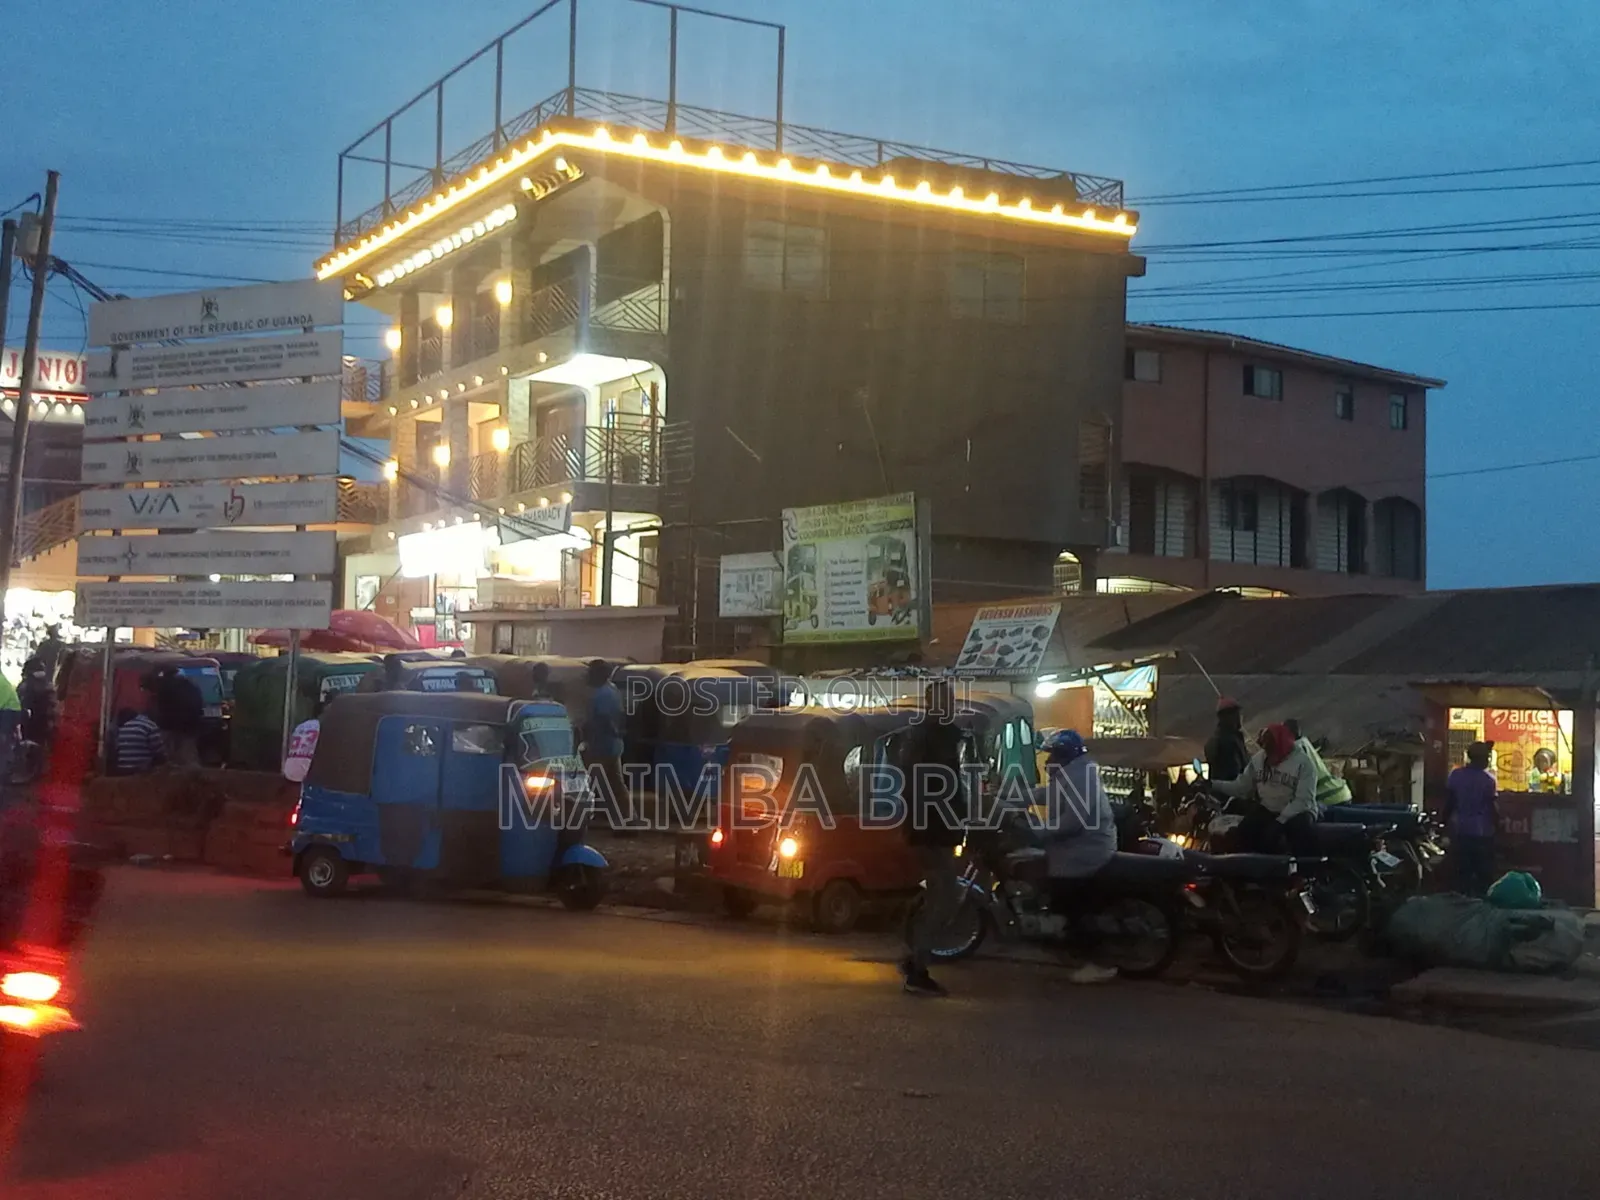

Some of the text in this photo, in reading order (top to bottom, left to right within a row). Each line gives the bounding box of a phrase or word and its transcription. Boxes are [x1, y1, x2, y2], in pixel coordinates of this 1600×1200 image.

[111, 313, 314, 342] GOVERNMENT OF THE REPUBLIC OF UGANDA
[6, 352, 89, 385] JNIO
[1509, 709, 1554, 724] airtel
